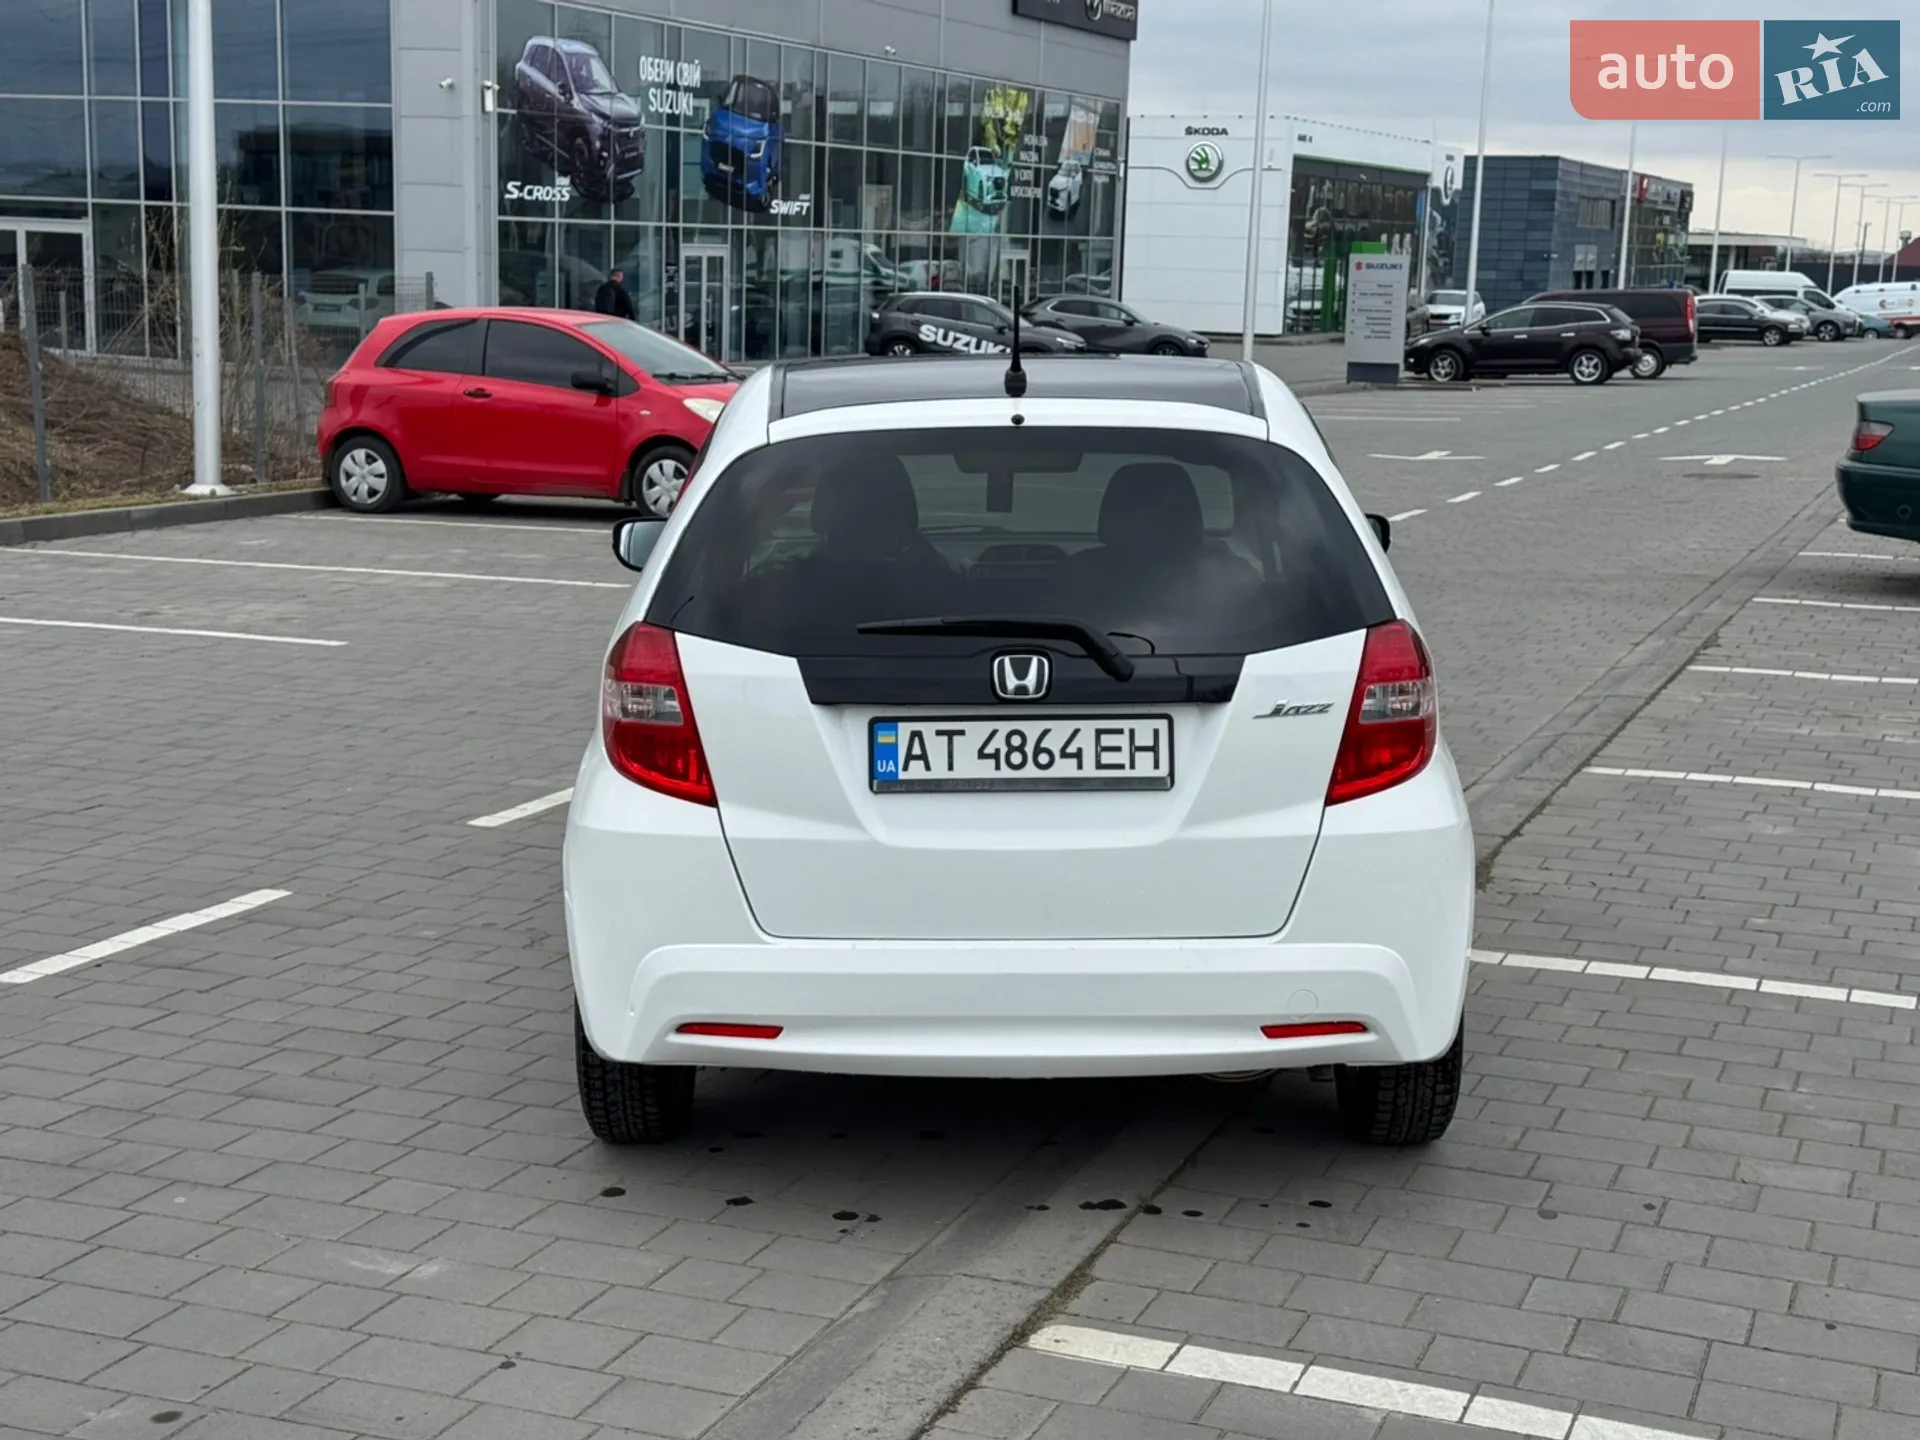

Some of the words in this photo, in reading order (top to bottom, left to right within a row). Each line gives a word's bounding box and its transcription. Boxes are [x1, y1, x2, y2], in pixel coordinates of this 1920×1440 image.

[639, 55, 675, 85] ОБЕРИ
[648, 87, 694, 116] SUZUKI
[769, 198, 811, 216] SWIFT
[1365, 262, 1403, 271] SUZUKI
[918, 323, 1012, 354] SUZUK
[901, 729, 967, 772] AT
[977, 728, 1084, 771] 4864
[1094, 728, 1161, 771] EH
[877, 759, 896, 773] UA
